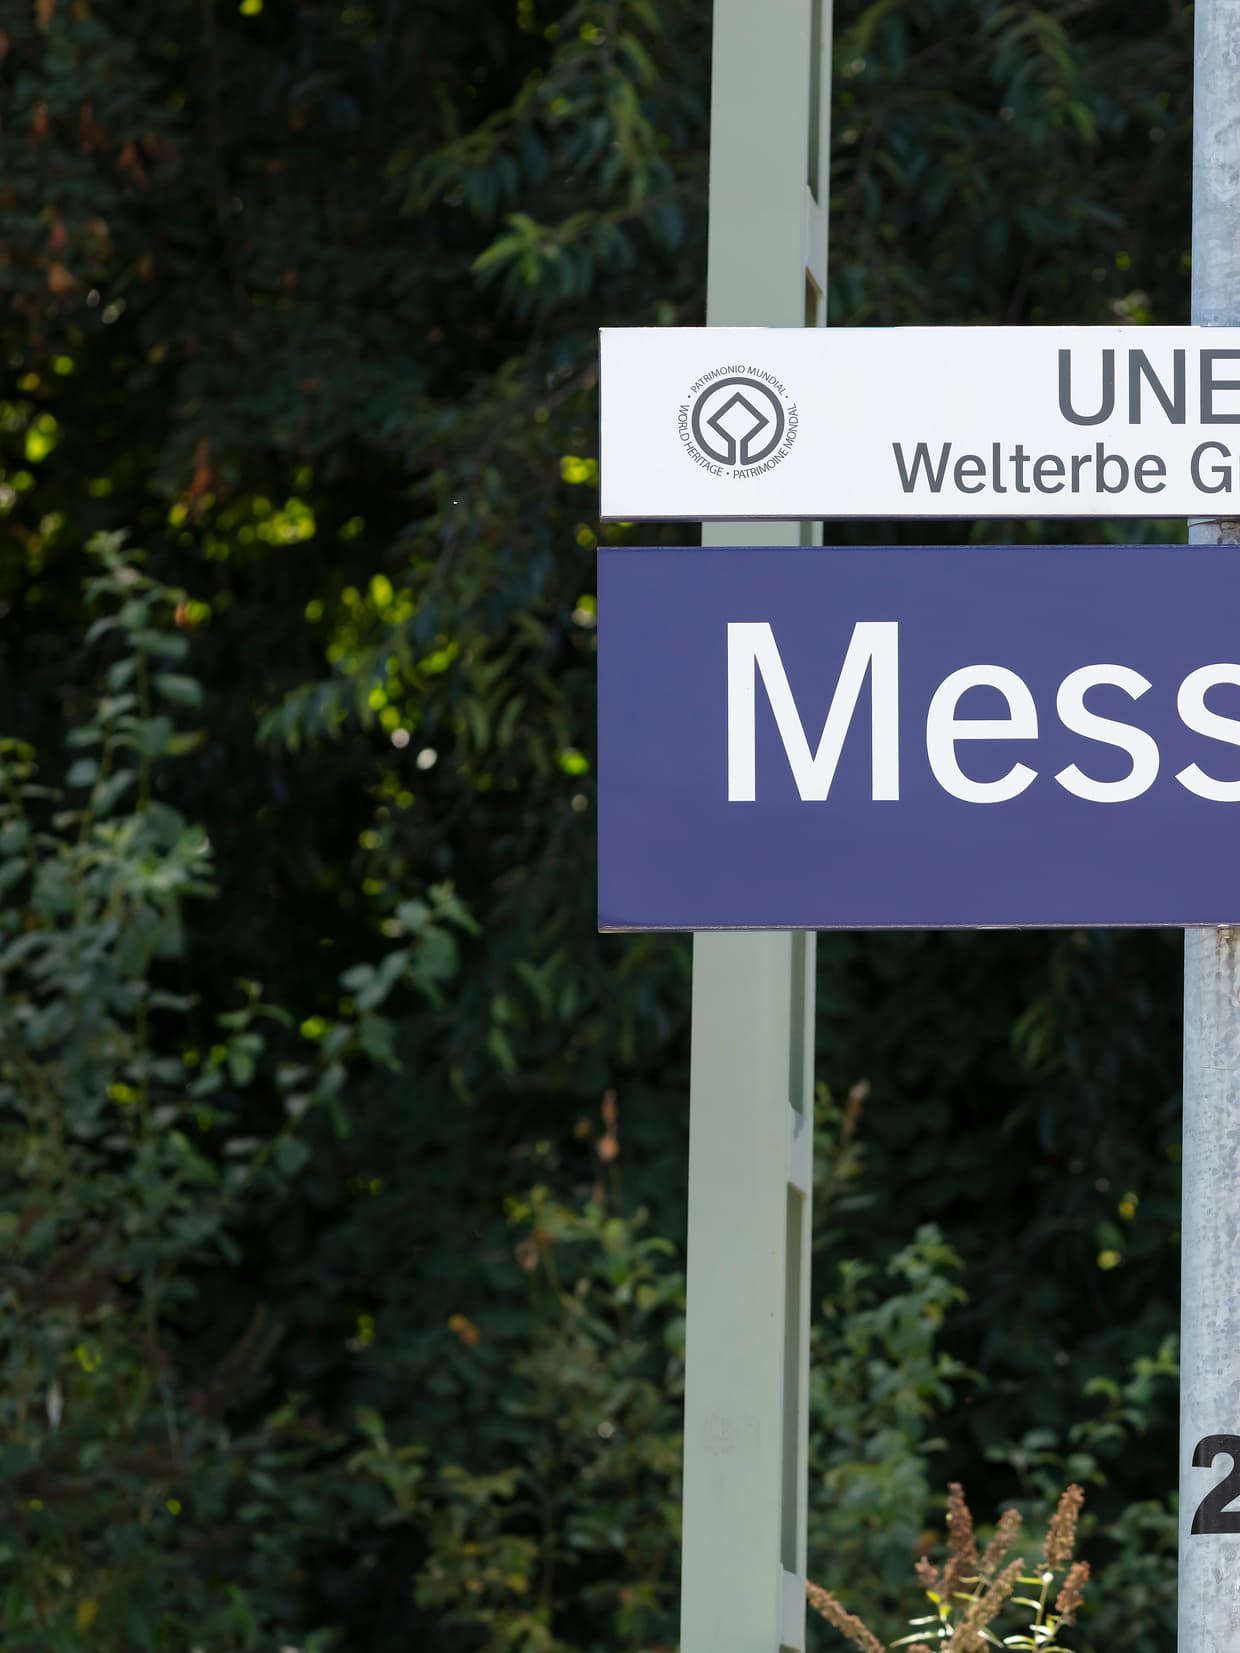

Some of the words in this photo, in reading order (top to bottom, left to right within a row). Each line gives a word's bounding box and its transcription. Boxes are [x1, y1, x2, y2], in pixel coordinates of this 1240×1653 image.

[690, 364, 746, 393] PATRIMONIO
[747, 366, 786, 396] MUNDIAL
[677, 404, 690, 442] WORLD
[683, 440, 723, 477] HERITAGE
[733, 447, 789, 479] PATRIMOINE
[892, 442, 1167, 494] Welterbe
